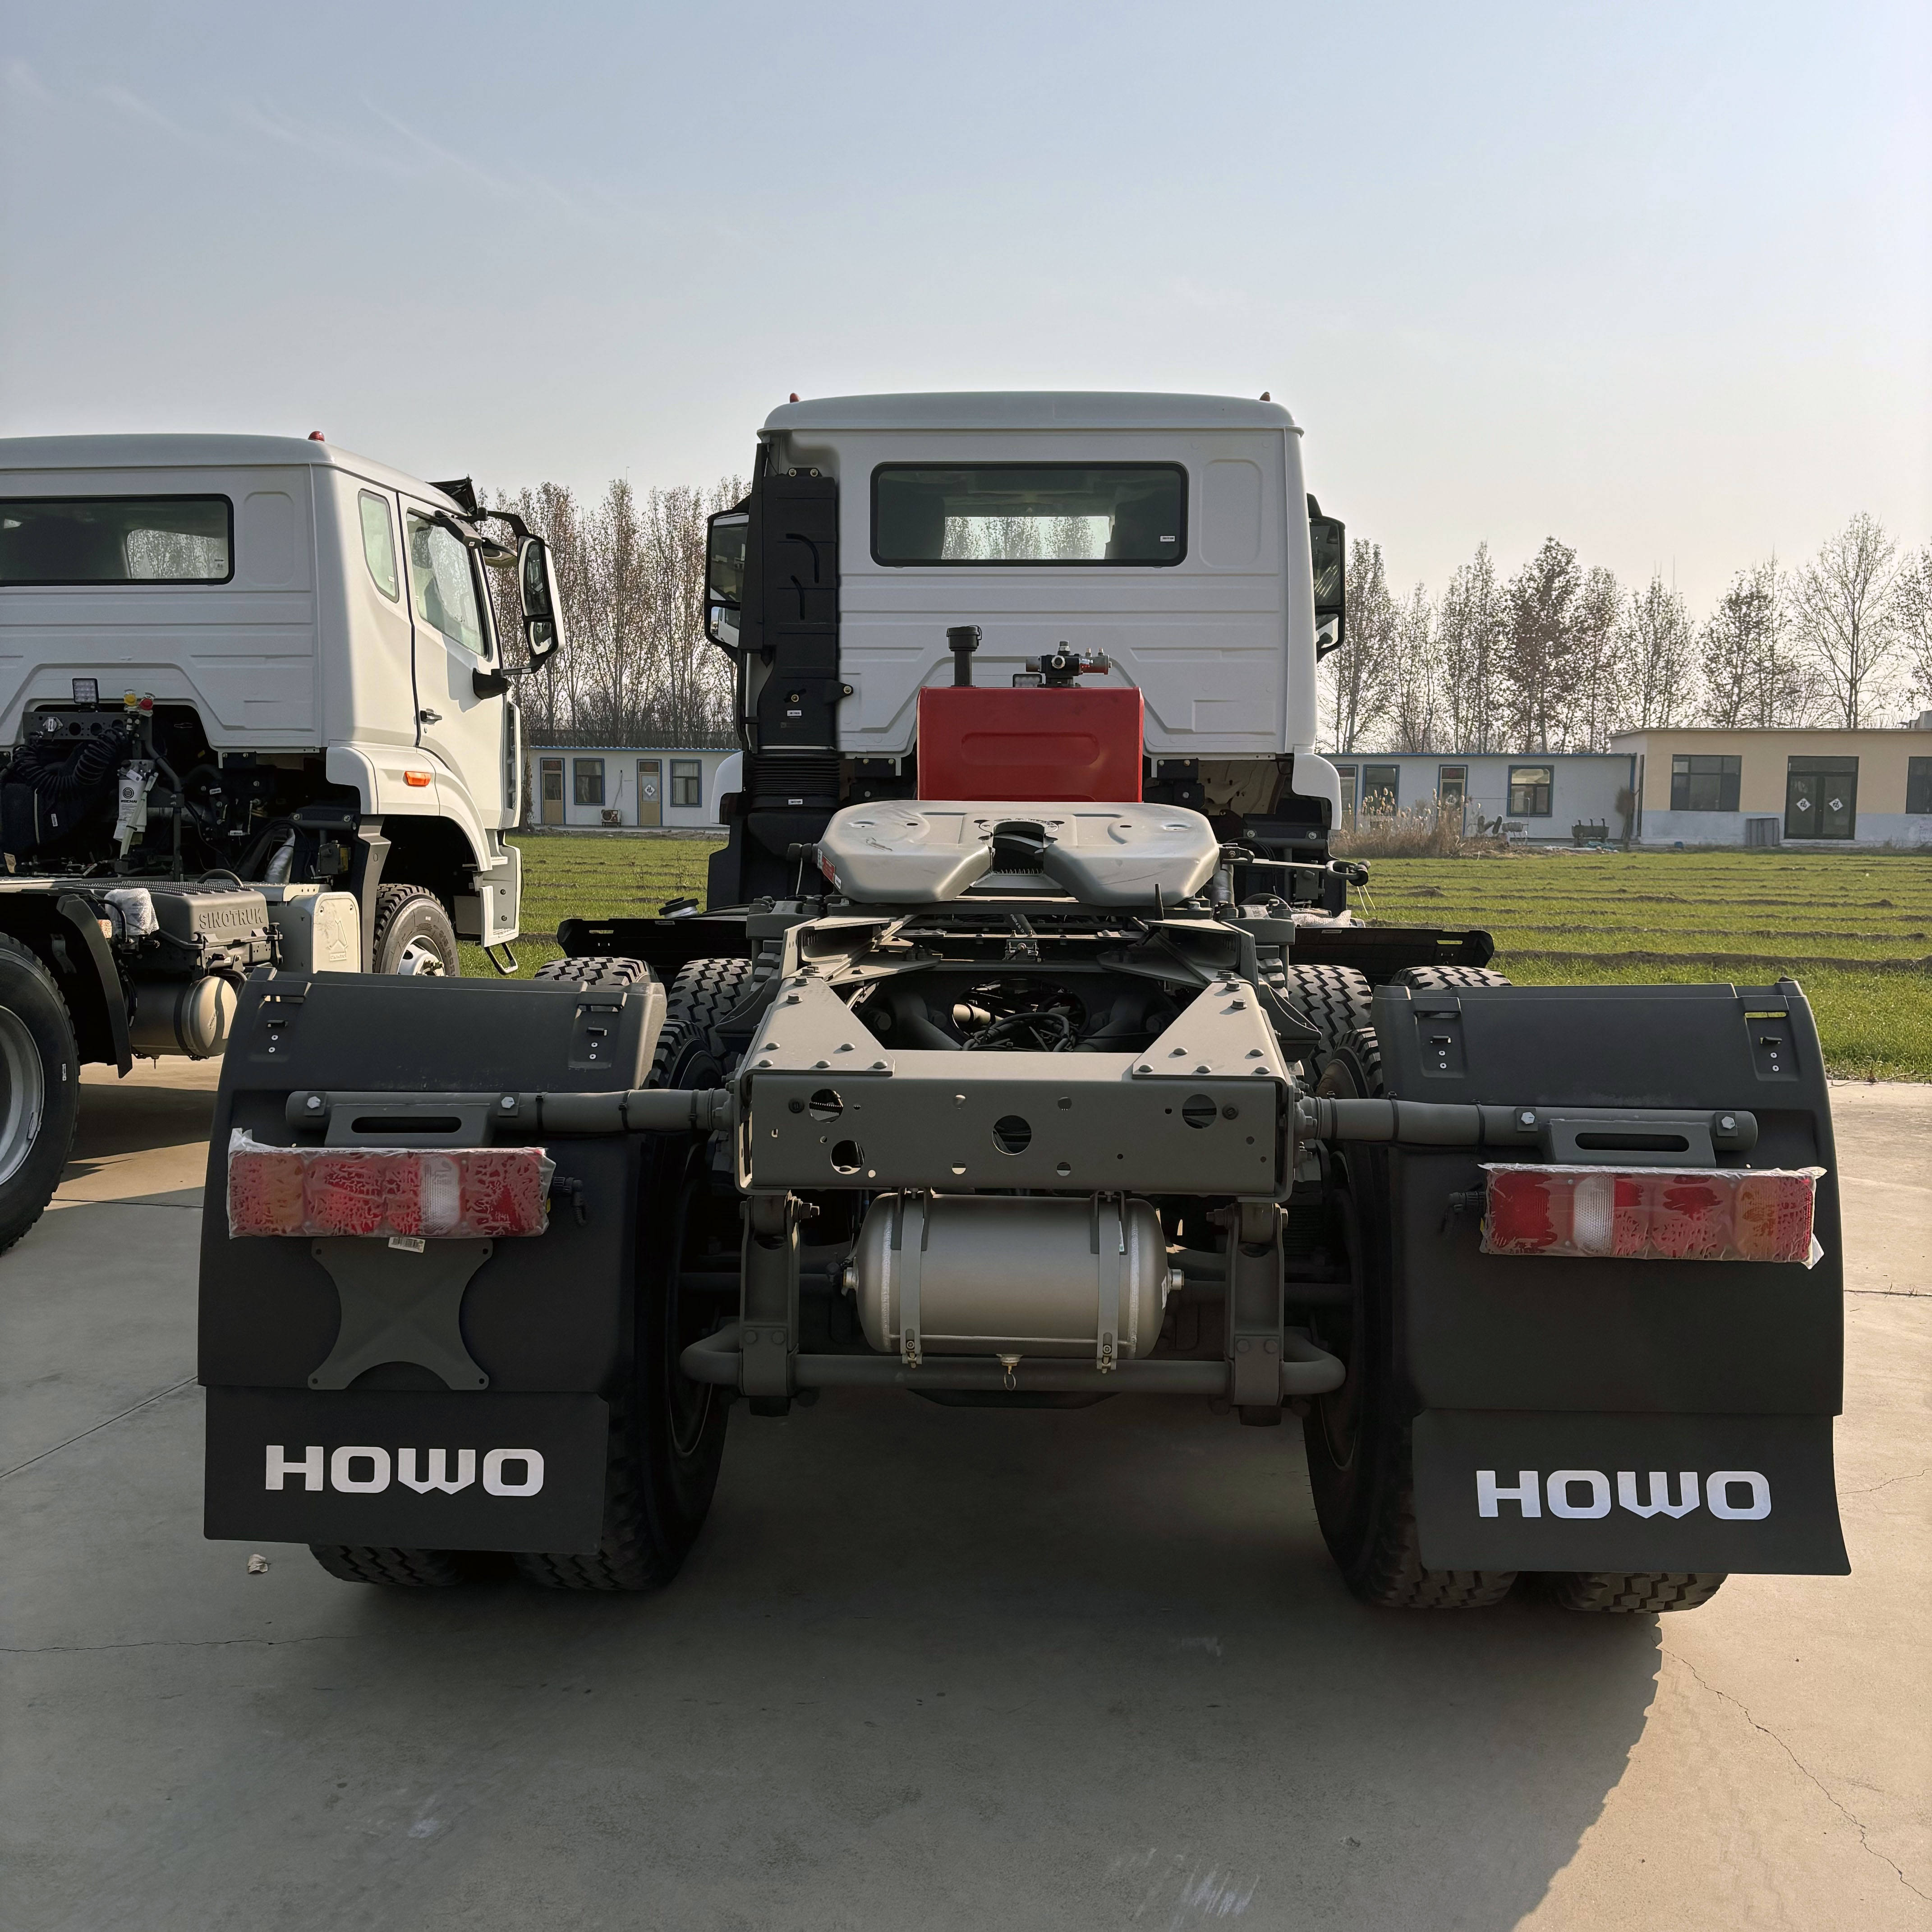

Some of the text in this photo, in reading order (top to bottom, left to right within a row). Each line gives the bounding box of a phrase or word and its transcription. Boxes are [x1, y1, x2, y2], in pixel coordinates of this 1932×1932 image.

[199, 908, 263, 929] SINOTRUK
[266, 1445, 544, 1496] HOWO
[1477, 1470, 1771, 1519] HOWO
